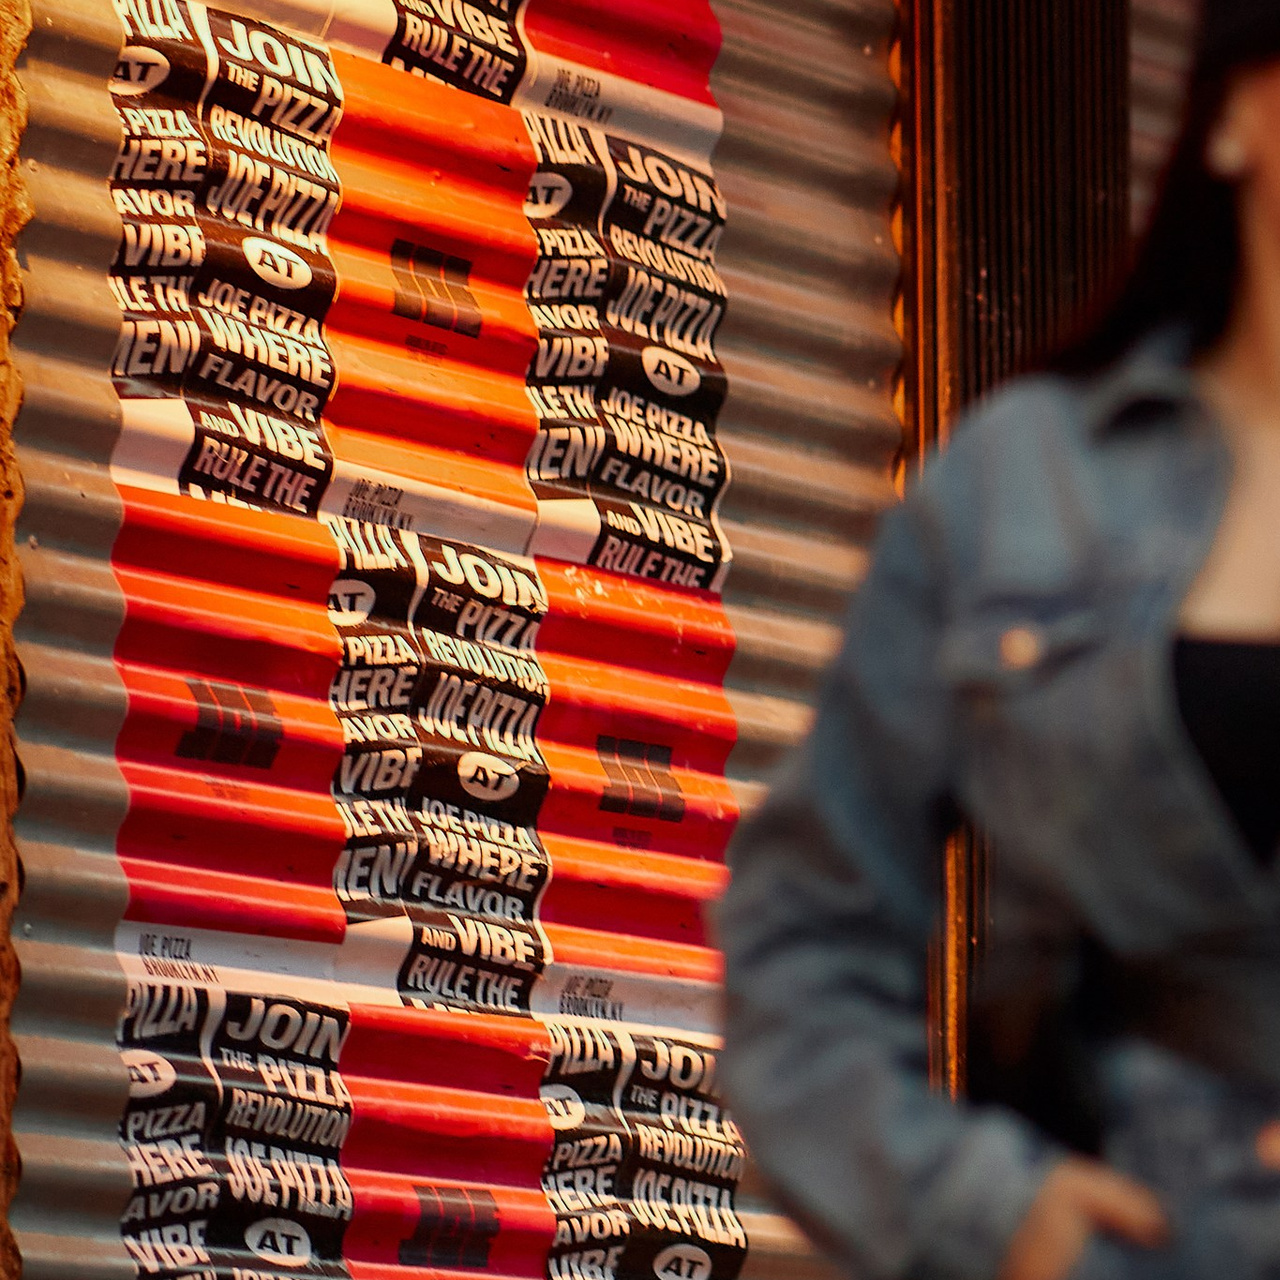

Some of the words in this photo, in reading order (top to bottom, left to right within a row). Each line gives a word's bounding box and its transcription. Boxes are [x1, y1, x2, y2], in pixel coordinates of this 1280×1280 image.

[218, 19, 344, 101] JOIN
[402, 12, 467, 73] RULE
[467, 44, 515, 97] THE
[226, 61, 259, 93] THE
[252, 77, 343, 145] PIZZA
[210, 104, 340, 184] REVOLUTION
[618, 145, 727, 220] JOIN
[610, 224, 728, 299] REVOLUTION
[643, 195, 725, 264] PIZZA
[197, 307, 332, 389] WHERE
[198, 278, 250, 318] JOE
[250, 296, 324, 349] PIZZA
[199, 353, 319, 422] FLAVOR
[601, 387, 646, 424] JOE
[645, 402, 714, 449] PIZZA
[199, 411, 240, 438] AND
[227, 400, 327, 470] VIBE
[604, 414, 719, 488] WHERE
[193, 436, 268, 492] RULE
[262, 459, 317, 513] THE
[601, 457, 705, 518] FLAVOR
[629, 501, 714, 563] VIBE
[432, 544, 549, 613] JOIN
[422, 627, 549, 696] REVOLUTION
[456, 597, 540, 657] PIZZA
[414, 795, 465, 835] JOE
[461, 810, 540, 856] PIZZA
[411, 871, 526, 925] FLAVOR
[447, 913, 535, 970] VIBE
[407, 954, 476, 1001] RULE
[473, 971, 523, 1013] THE
[226, 997, 351, 1063] JOIN
[219, 1047, 255, 1072] THE
[257, 1054, 352, 1108] PIZZA
[641, 1040, 721, 1098] JOI
[226, 1087, 350, 1148] REVOLUTION
[661, 1092, 745, 1145] PIZZA
